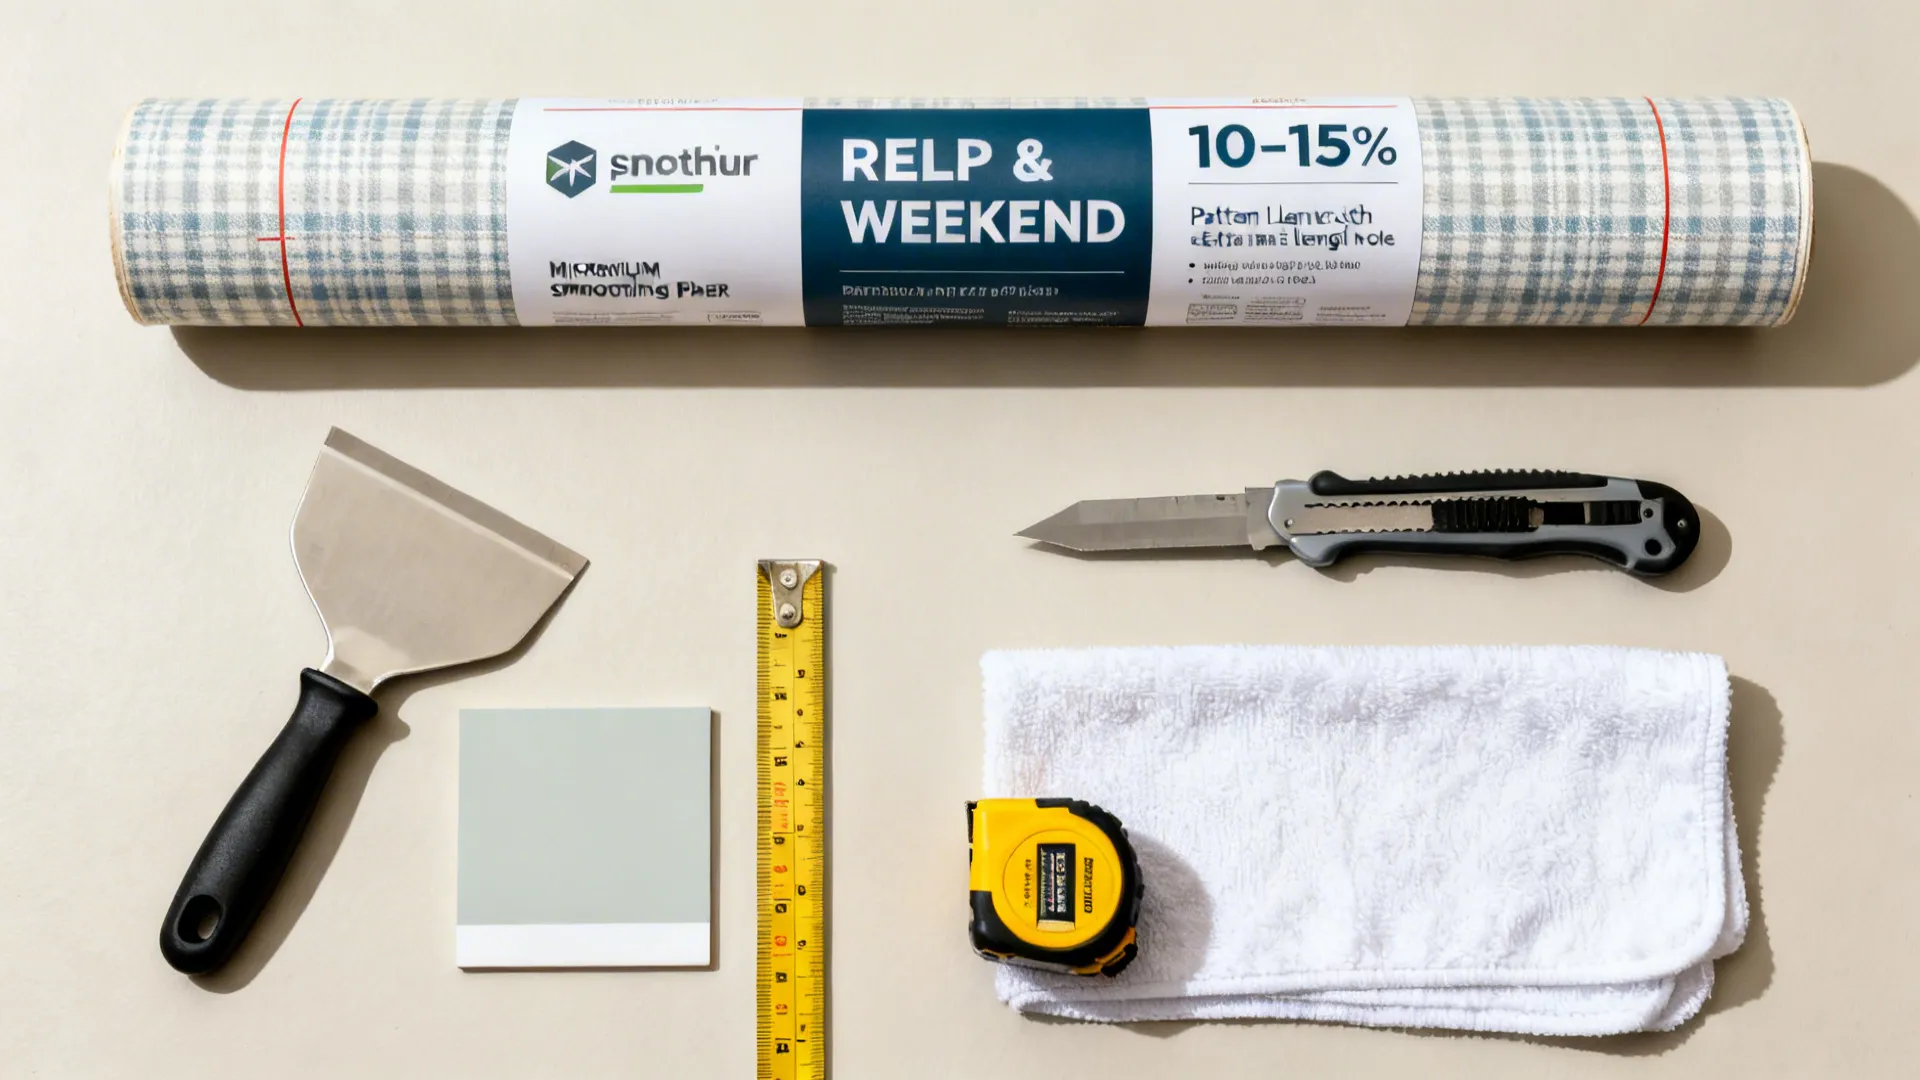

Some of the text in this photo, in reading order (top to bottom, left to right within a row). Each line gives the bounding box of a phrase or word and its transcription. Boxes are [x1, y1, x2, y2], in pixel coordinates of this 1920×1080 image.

[842, 138, 1054, 183] RELP &
[840, 199, 1126, 244] WEEKEND
